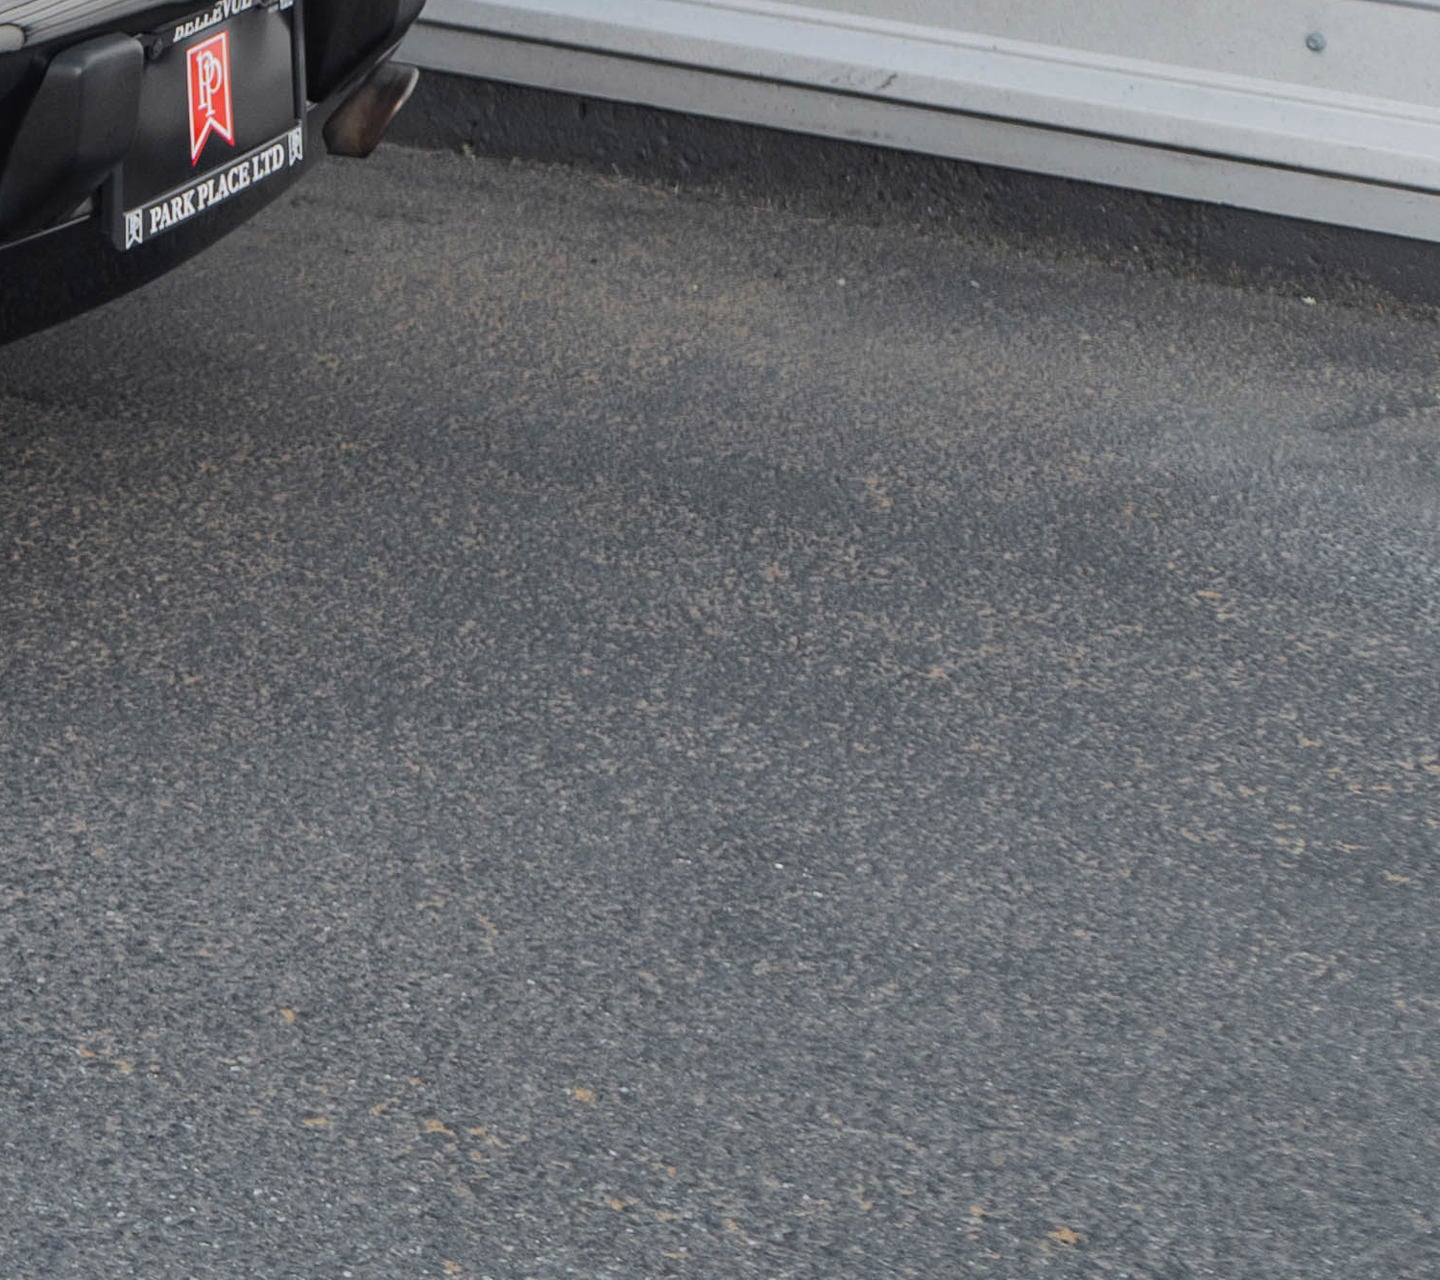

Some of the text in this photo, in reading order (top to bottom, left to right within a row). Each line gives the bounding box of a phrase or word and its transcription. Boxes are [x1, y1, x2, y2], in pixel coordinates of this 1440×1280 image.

[149, 189, 197, 235] PARK
[196, 163, 251, 212] PLACE
[252, 143, 285, 183] LTD
